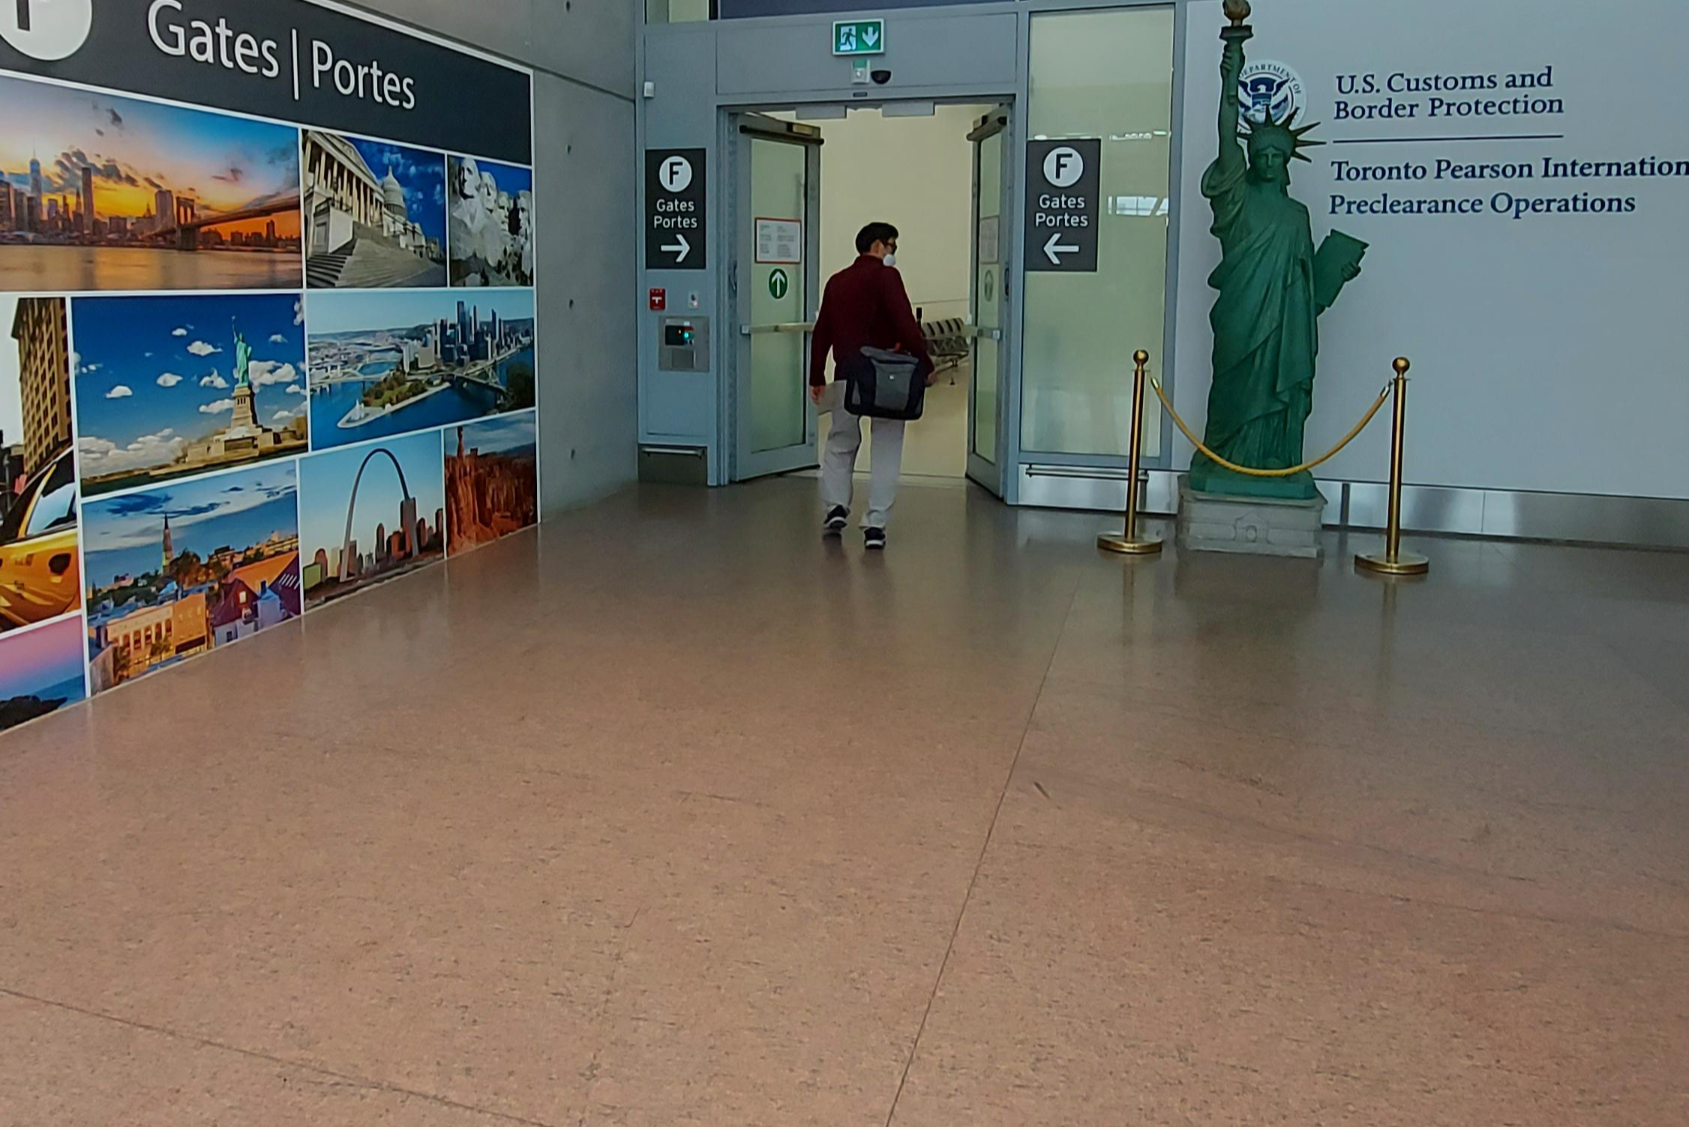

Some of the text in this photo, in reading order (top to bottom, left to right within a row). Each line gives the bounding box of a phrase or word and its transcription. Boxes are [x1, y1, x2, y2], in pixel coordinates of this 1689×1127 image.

[312, 39, 416, 110] Portes
[1336, 66, 1553, 94] U.S. Customs and
[1334, 94, 1565, 120] Border Protection
[669, 162, 683, 185] F
[1056, 153, 1073, 179] F
[1331, 159, 1428, 181] Toronto
[1434, 158, 1534, 180] Pearson
[656, 199, 695, 212] Gates
[1039, 194, 1085, 208] Gates
[1329, 191, 1636, 219] Preclearance Operations
[653, 215, 698, 228] Portes
[1035, 212, 1088, 227] Portes
